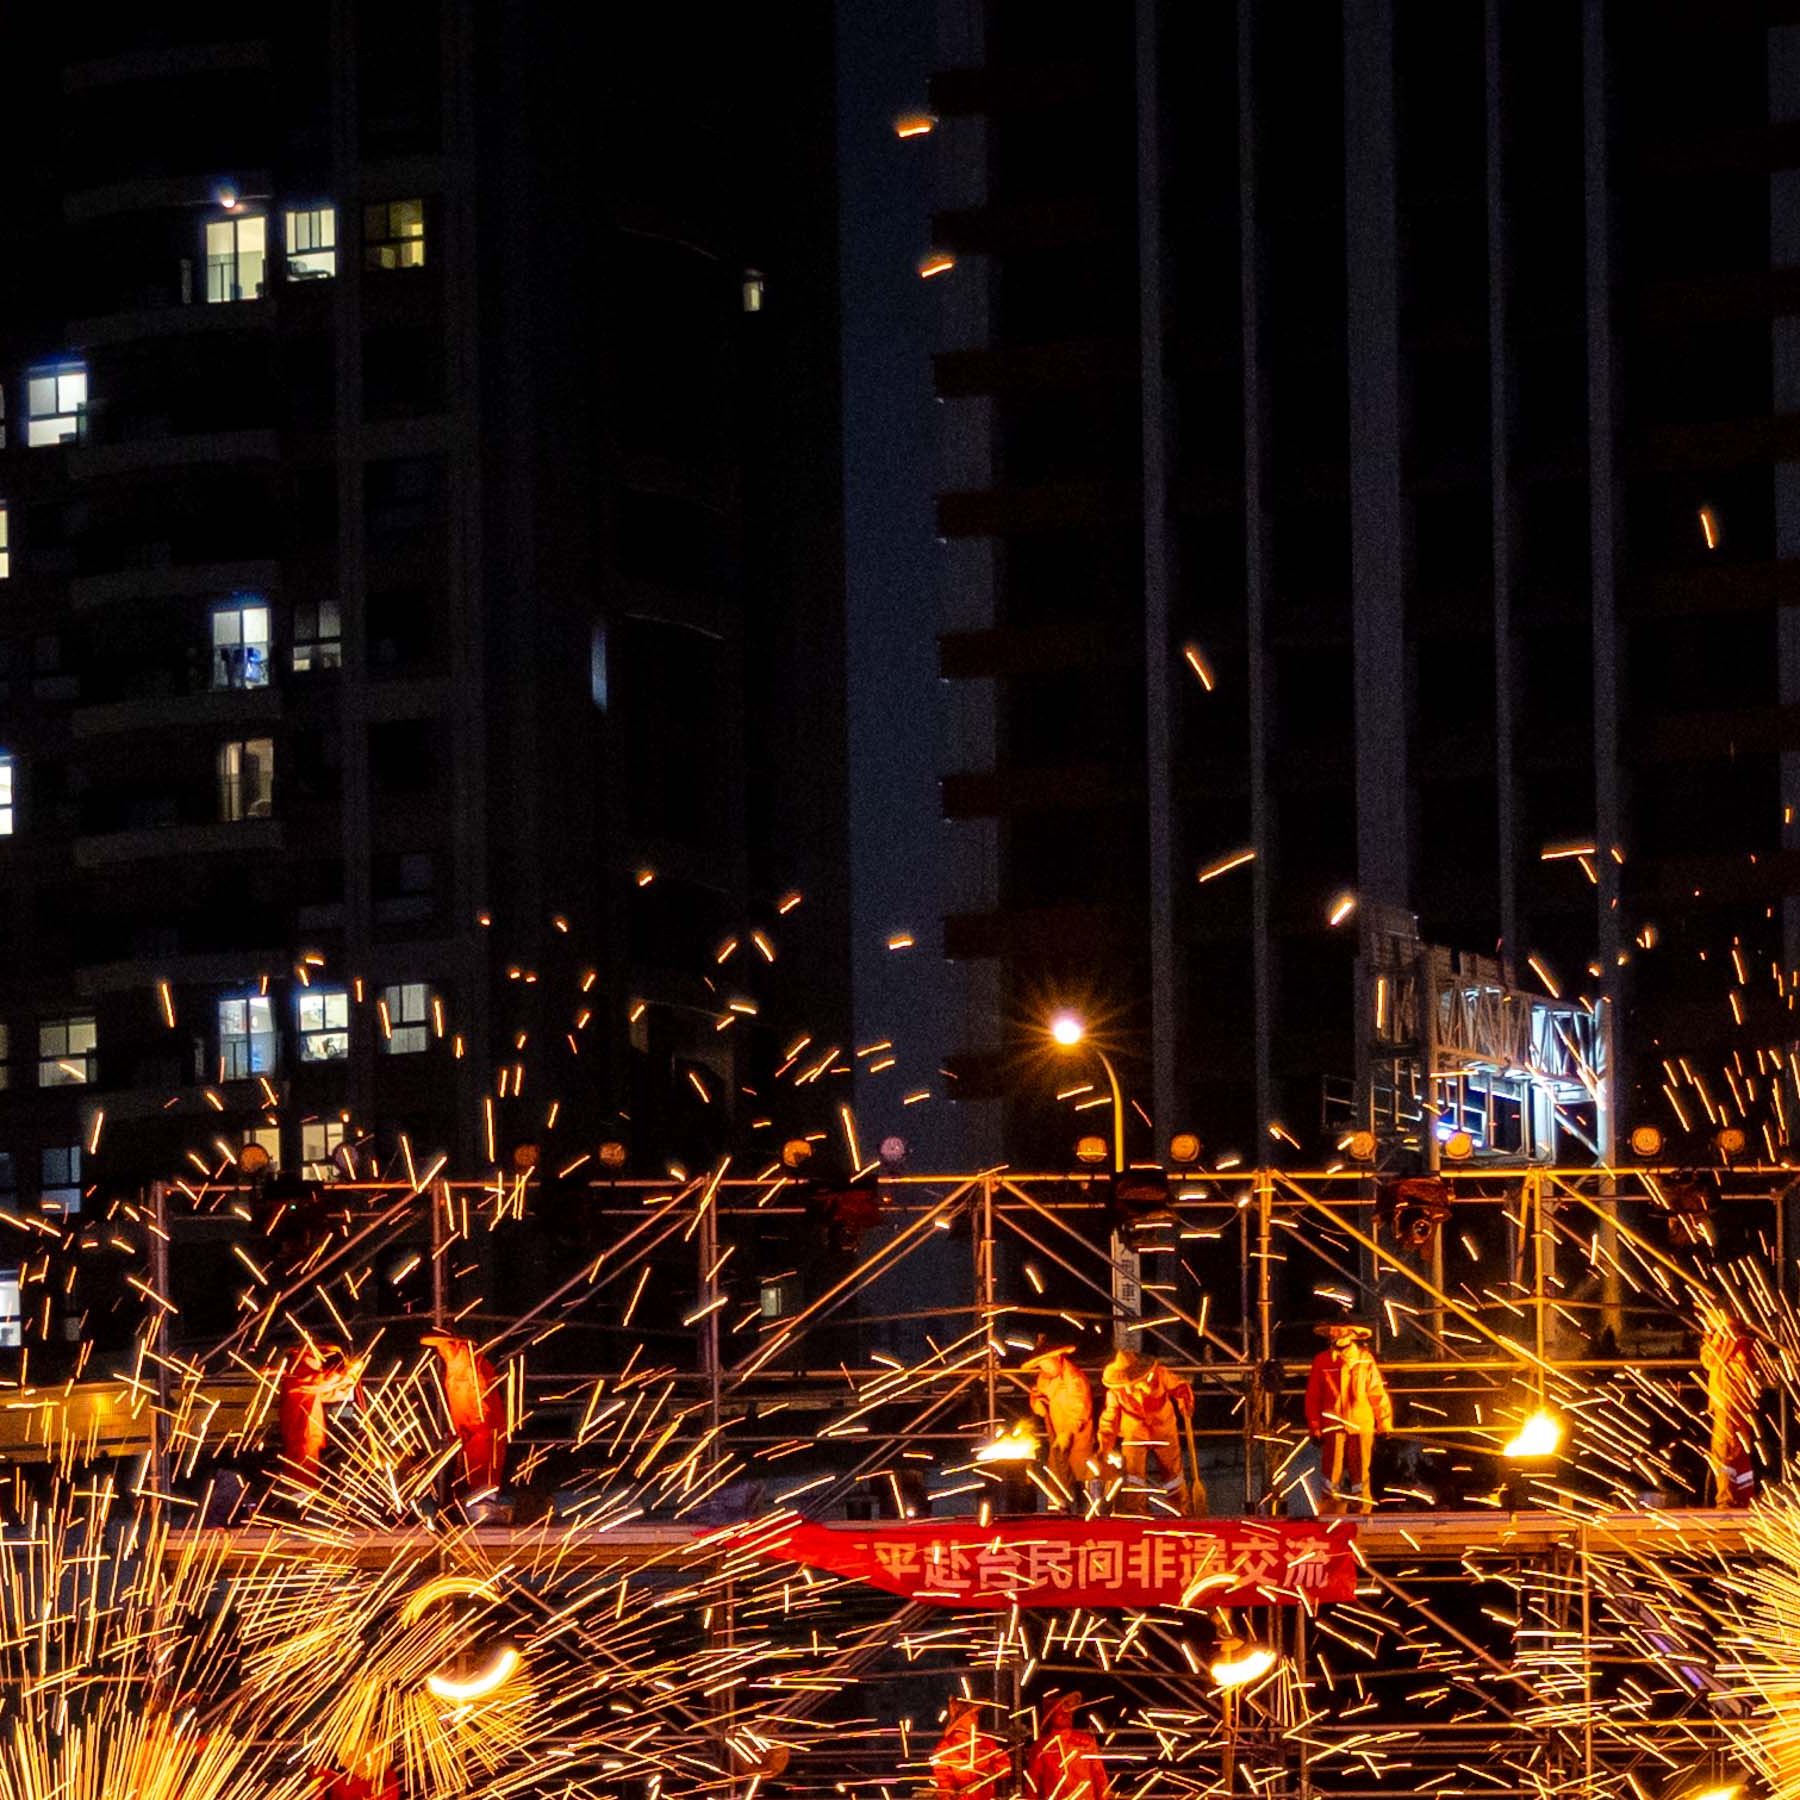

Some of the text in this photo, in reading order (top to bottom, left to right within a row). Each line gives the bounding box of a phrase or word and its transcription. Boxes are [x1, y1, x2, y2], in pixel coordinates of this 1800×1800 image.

[853, 1537, 1330, 1589] 平赴台民间非遗交流
